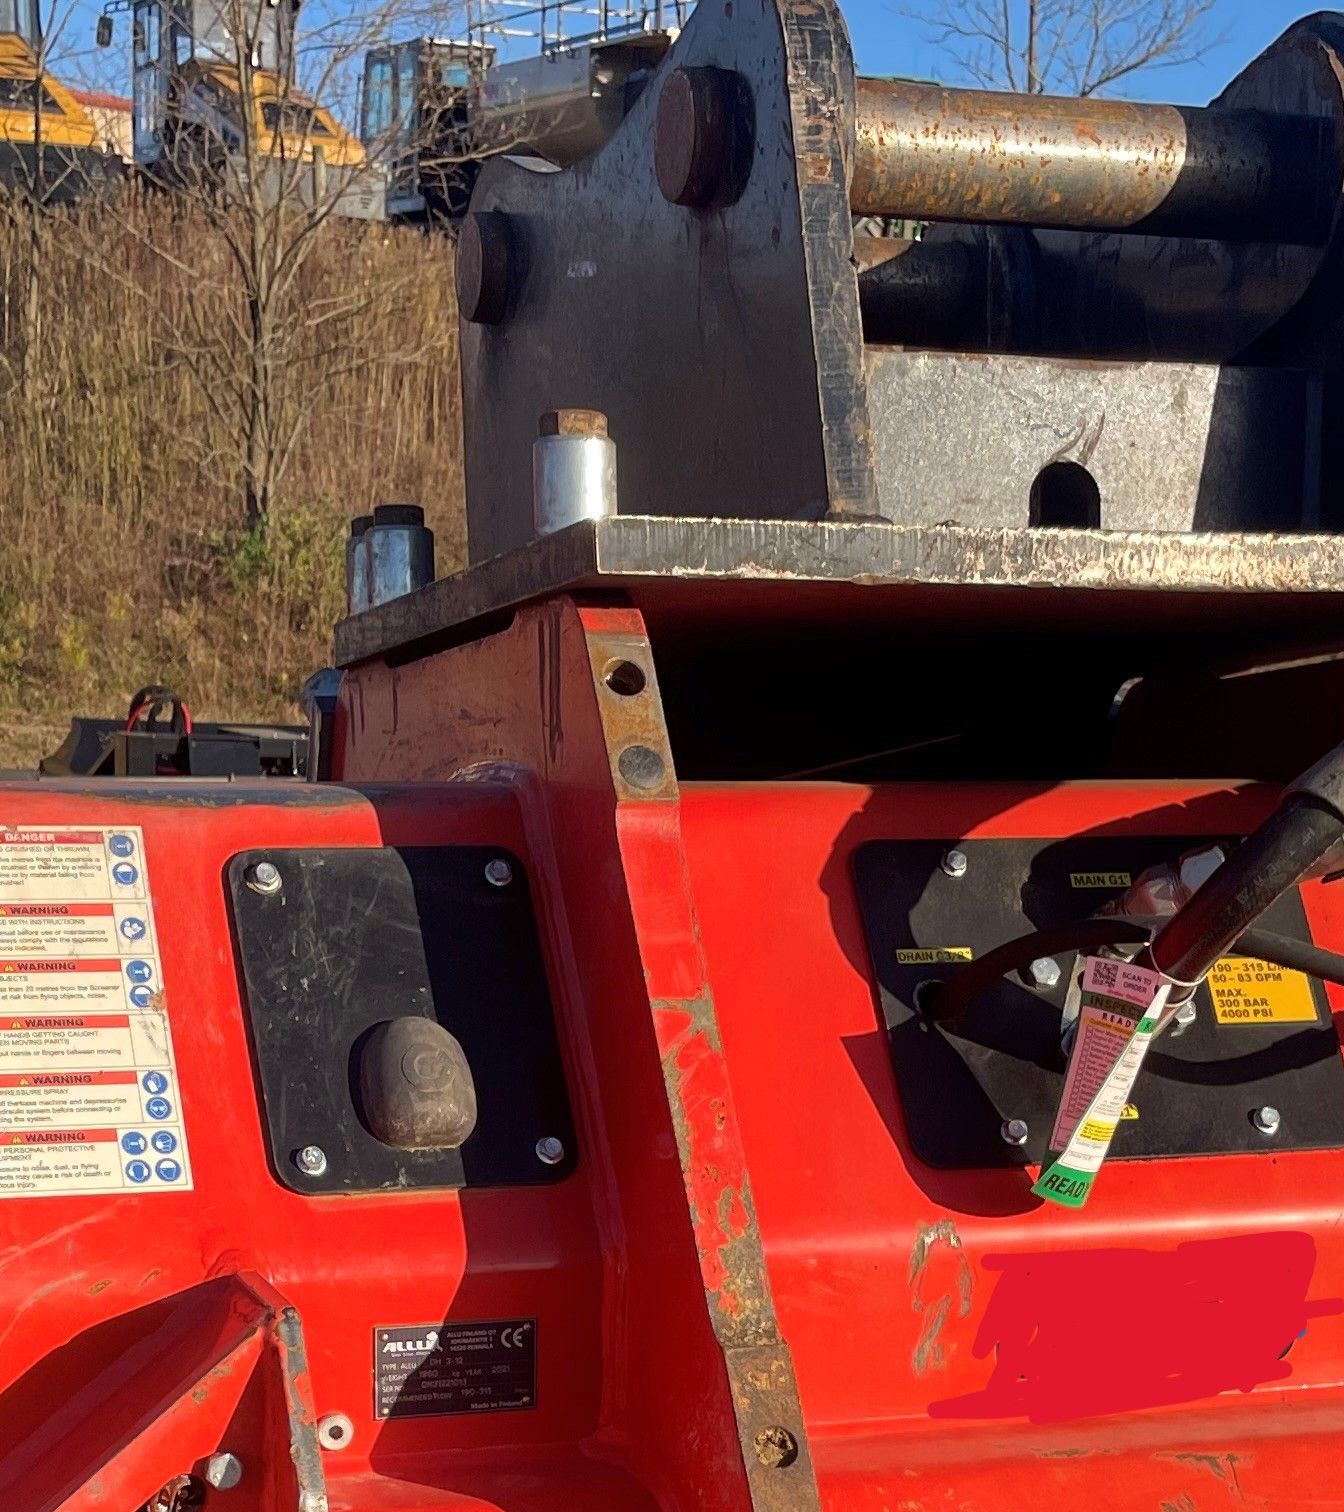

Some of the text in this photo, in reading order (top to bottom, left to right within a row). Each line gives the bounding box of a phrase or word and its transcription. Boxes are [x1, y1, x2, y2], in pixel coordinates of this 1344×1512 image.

[5, 833, 56, 842] DANGER
[1074, 875, 1106, 886] MAIN
[10, 906, 68, 914] WARNING
[898, 951, 933, 962] DRAIN
[17, 963, 76, 971] WARNING
[1122, 972, 1142, 982] SCAN
[1212, 973, 1282, 982] 50 83 GPM
[1123, 981, 1147, 993] ORDER
[1216, 989, 1247, 997] MAX.
[1218, 998, 1269, 1008] 300 BAR
[1221, 1009, 1273, 1018] 4000 PSI
[25, 1019, 84, 1028] WARNING
[32, 1076, 92, 1084] WARNING
[26, 1132, 85, 1142] WARNING
[4, 1146, 45, 1154] PERSONAL
[382, 1340, 432, 1353] ALLU
